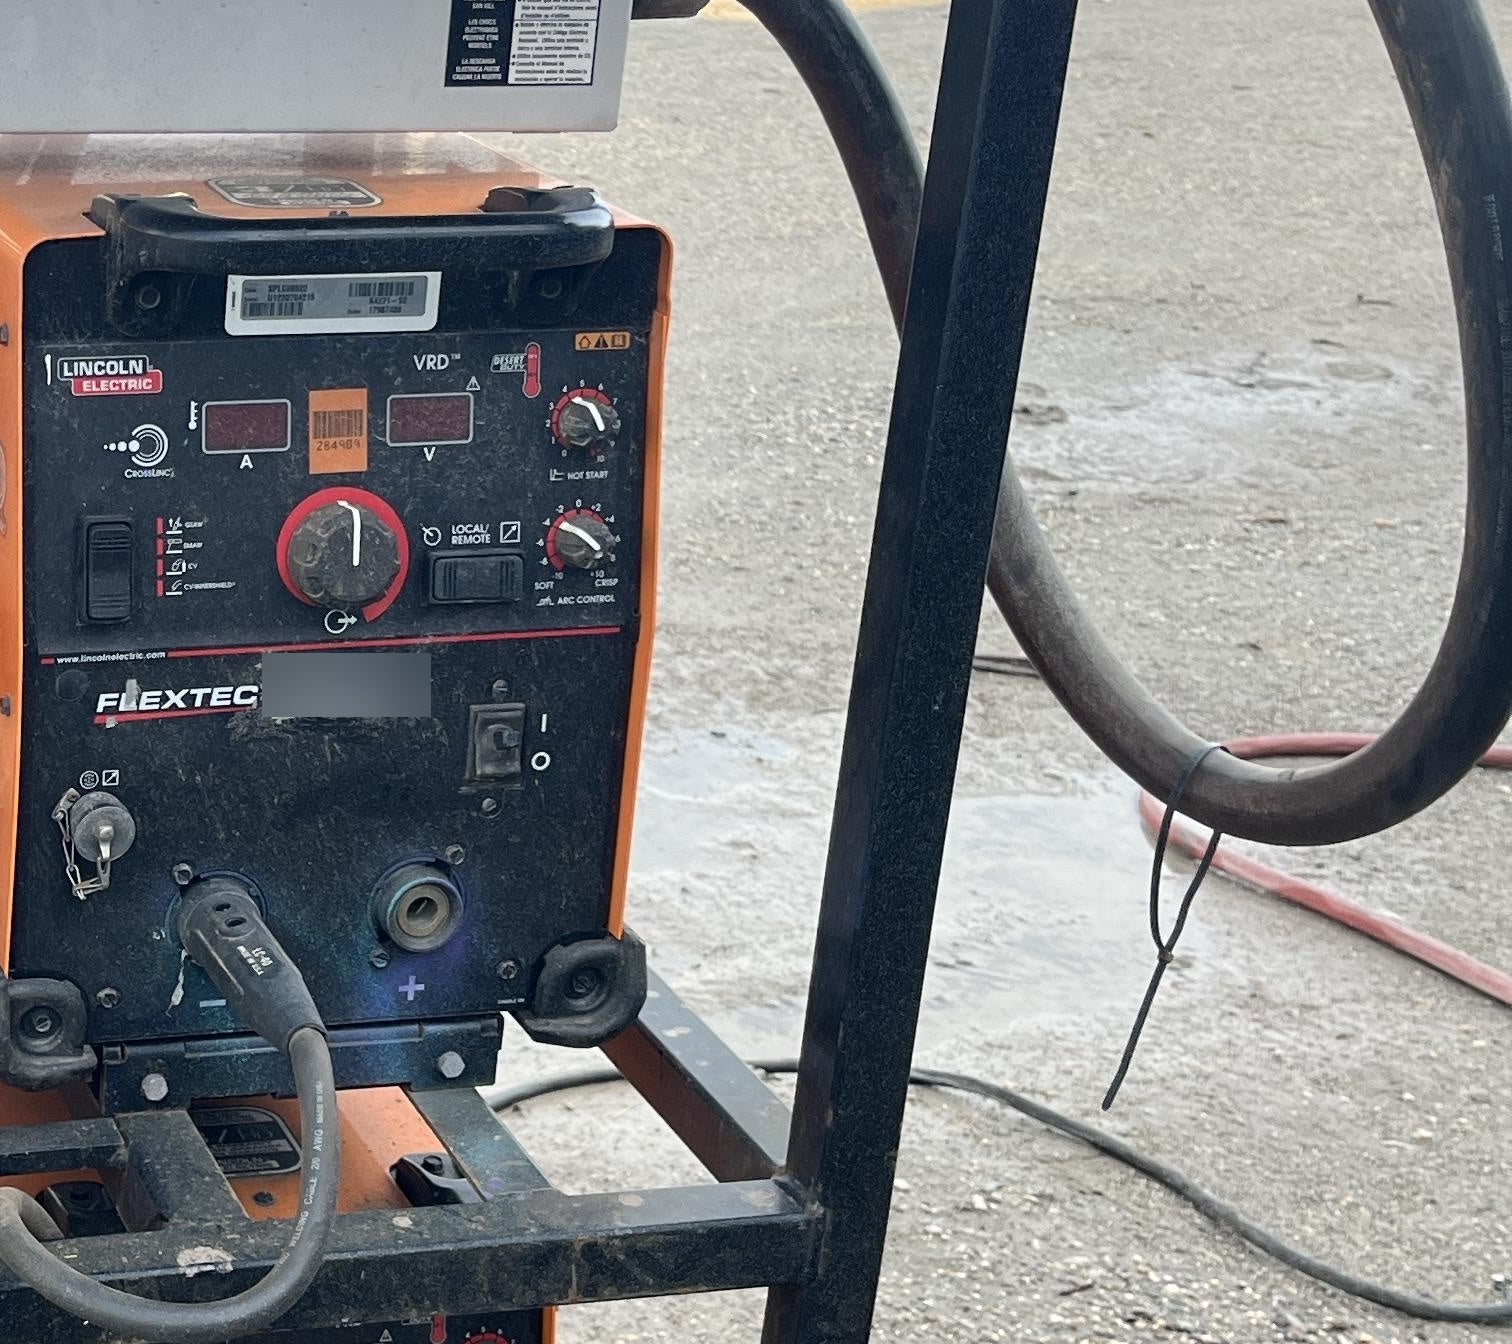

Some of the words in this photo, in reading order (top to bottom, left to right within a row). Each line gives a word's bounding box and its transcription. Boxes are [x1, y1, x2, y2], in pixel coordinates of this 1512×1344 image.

[493, 356, 524, 365] DESERT
[63, 360, 143, 376] LINCOLN
[82, 378, 152, 392] ELECTRIC
[316, 438, 361, 451] 284909
[424, 446, 436, 462] V
[240, 454, 254, 470] A
[568, 472, 584, 480] HOT
[585, 470, 608, 479] START
[452, 524, 490, 534] LOCAL/
[451, 534, 490, 544] REMOTE
[534, 581, 554, 590] SOFT
[594, 578, 618, 587] CRISP
[558, 596, 576, 605] ARC
[576, 594, 616, 604] CONTROL
[56, 652, 166, 664] www.lincolnelectric.com
[96, 685, 259, 713] FLEXTEC
[304, 1176, 318, 1205] CABLE
[313, 1129, 323, 1152] AWG
